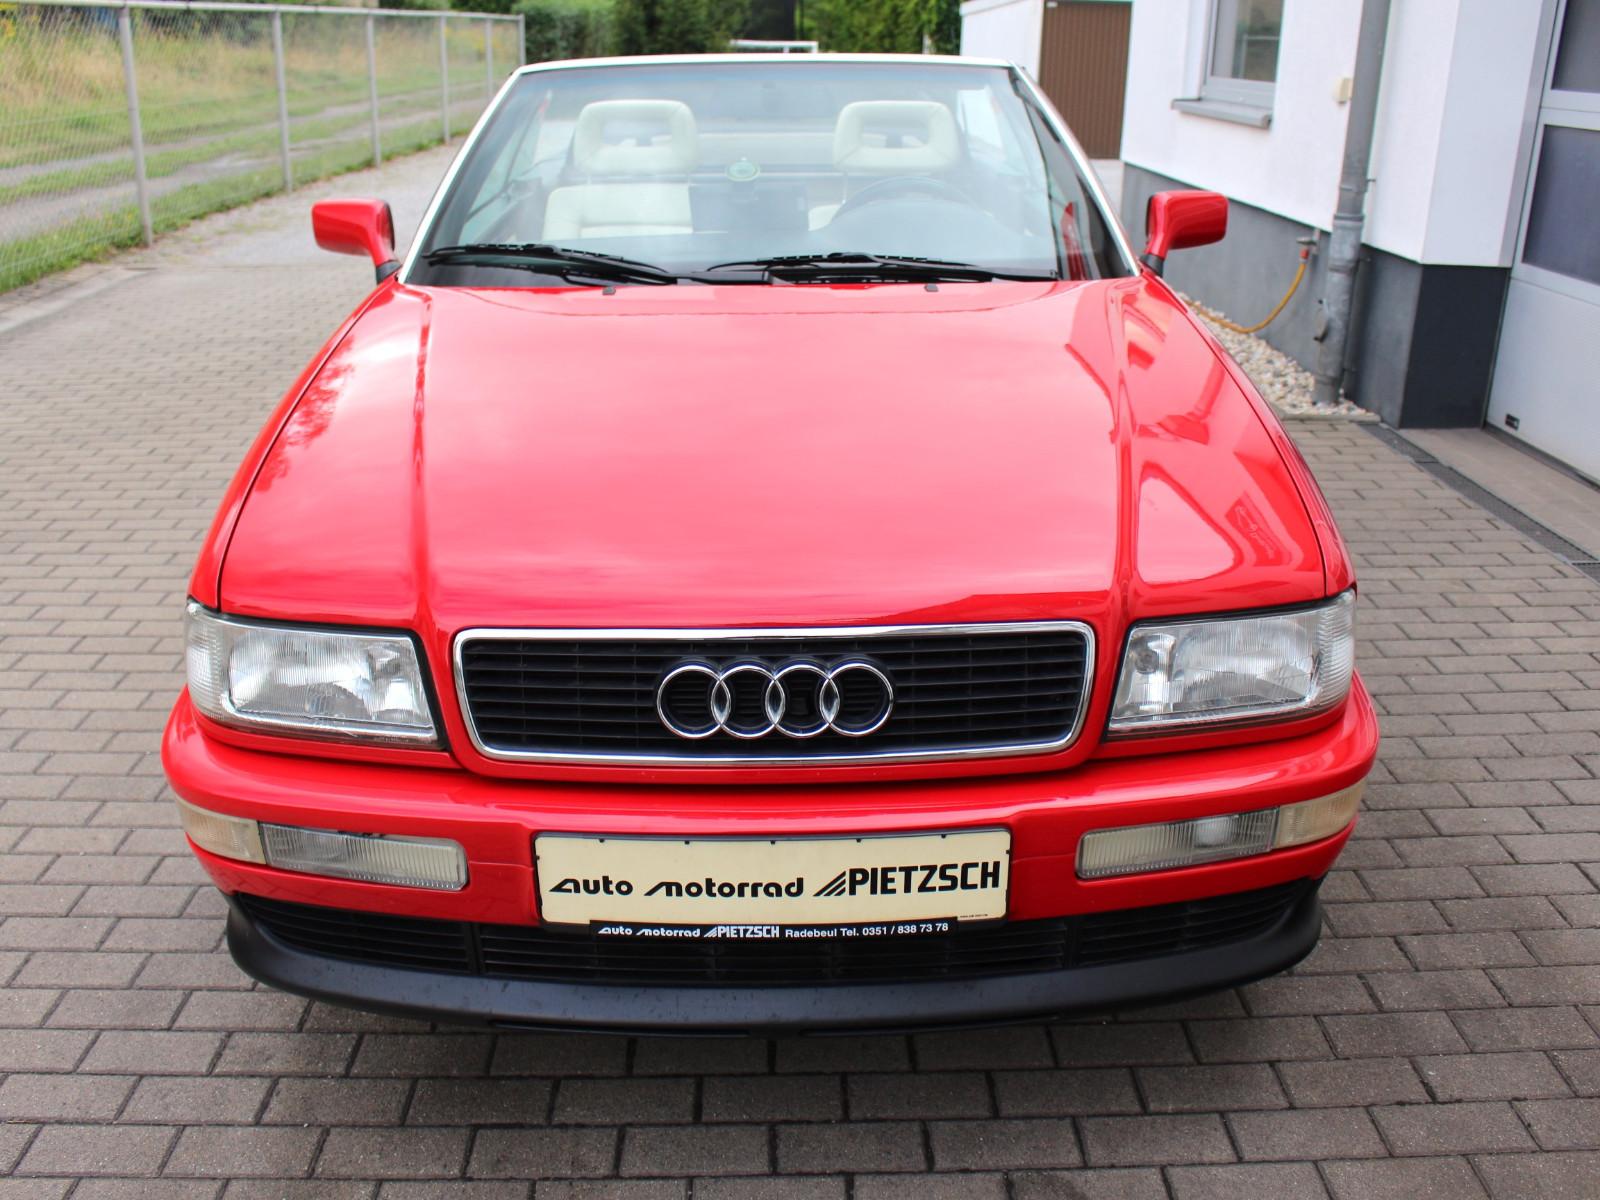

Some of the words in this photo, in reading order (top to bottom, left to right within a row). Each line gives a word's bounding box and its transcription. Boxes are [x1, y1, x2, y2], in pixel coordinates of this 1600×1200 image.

[550, 875, 633, 895] Auto
[848, 860, 1000, 896] PIETZSCH
[598, 925, 632, 936] Auto
[717, 925, 780, 938] PIETZSCH
[785, 928, 837, 938] Radebeul
[840, 927, 859, 937] Tel.
[862, 926, 887, 936] 0351
[898, 925, 916, 935] 838
[920, 923, 933, 933] 73
[936, 922, 949, 932] 78
